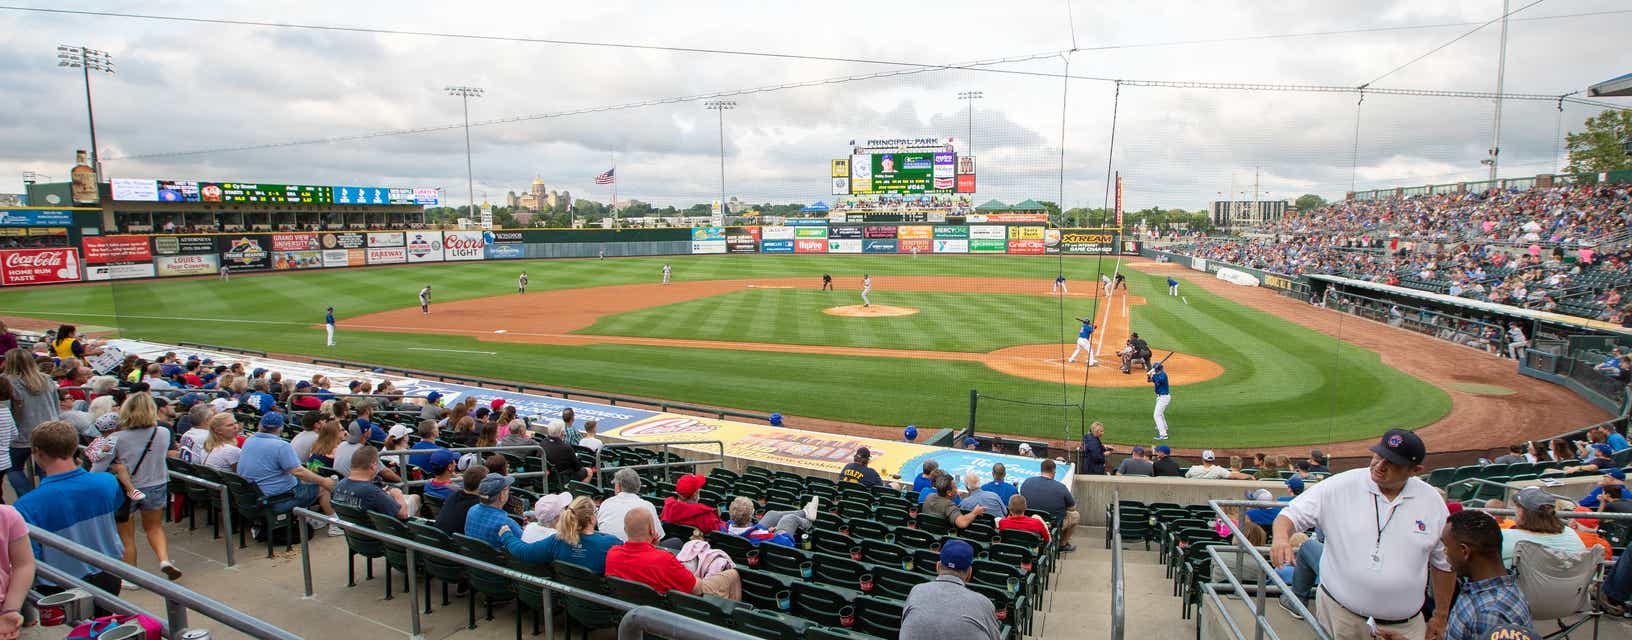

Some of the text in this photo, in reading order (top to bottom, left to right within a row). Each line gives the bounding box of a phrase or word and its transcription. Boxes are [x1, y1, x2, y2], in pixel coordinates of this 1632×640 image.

[867, 138, 914, 146] PRINCIPAL
[444, 234, 485, 249] Coors
[1063, 234, 1113, 243] XTREAM
[452, 249, 478, 257] LIGHT
[6, 251, 63, 268] Coca-Cola
[174, 256, 202, 264] LOUIE'S
[183, 262, 210, 270] Covering
[34, 268, 51, 276] RUN
[844, 469, 864, 479] STAFF
